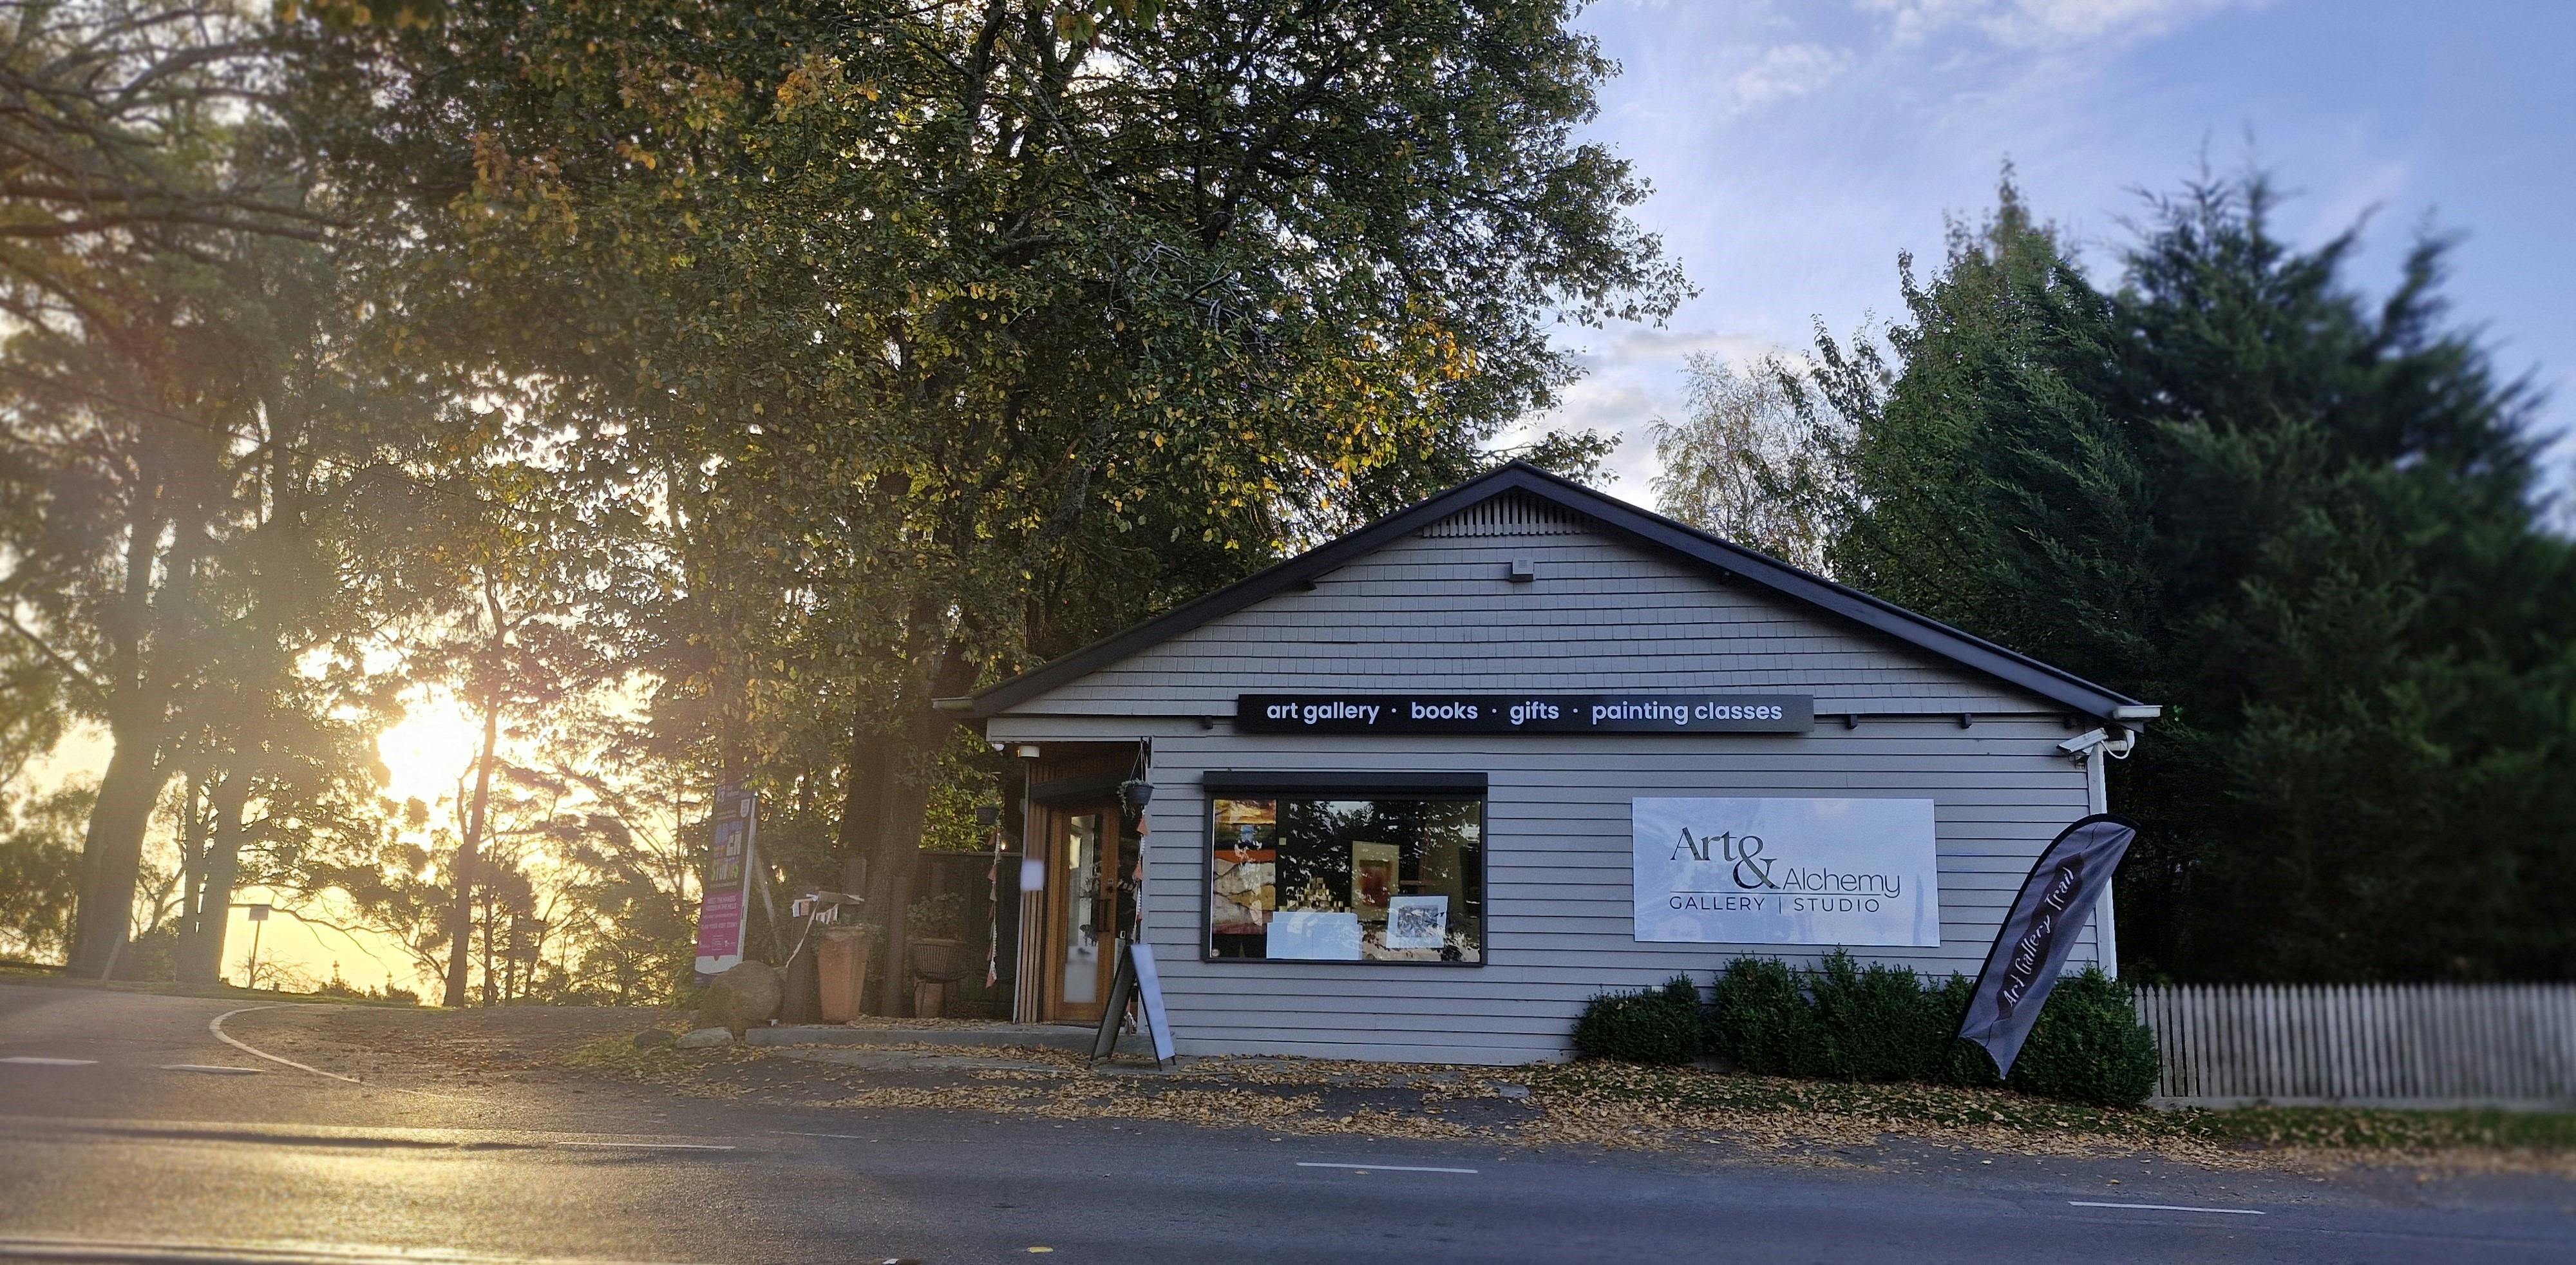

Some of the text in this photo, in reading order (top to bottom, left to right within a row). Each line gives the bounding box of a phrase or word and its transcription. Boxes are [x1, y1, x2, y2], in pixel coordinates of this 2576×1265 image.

[1267, 701, 1783, 725] art gallery books gifts painting classes
[1669, 826, 1900, 899] Art & Alchemy
[1669, 896, 1879, 913] GALLERY STUDIO
[2003, 866, 2074, 1007] Art Gallery Trail
